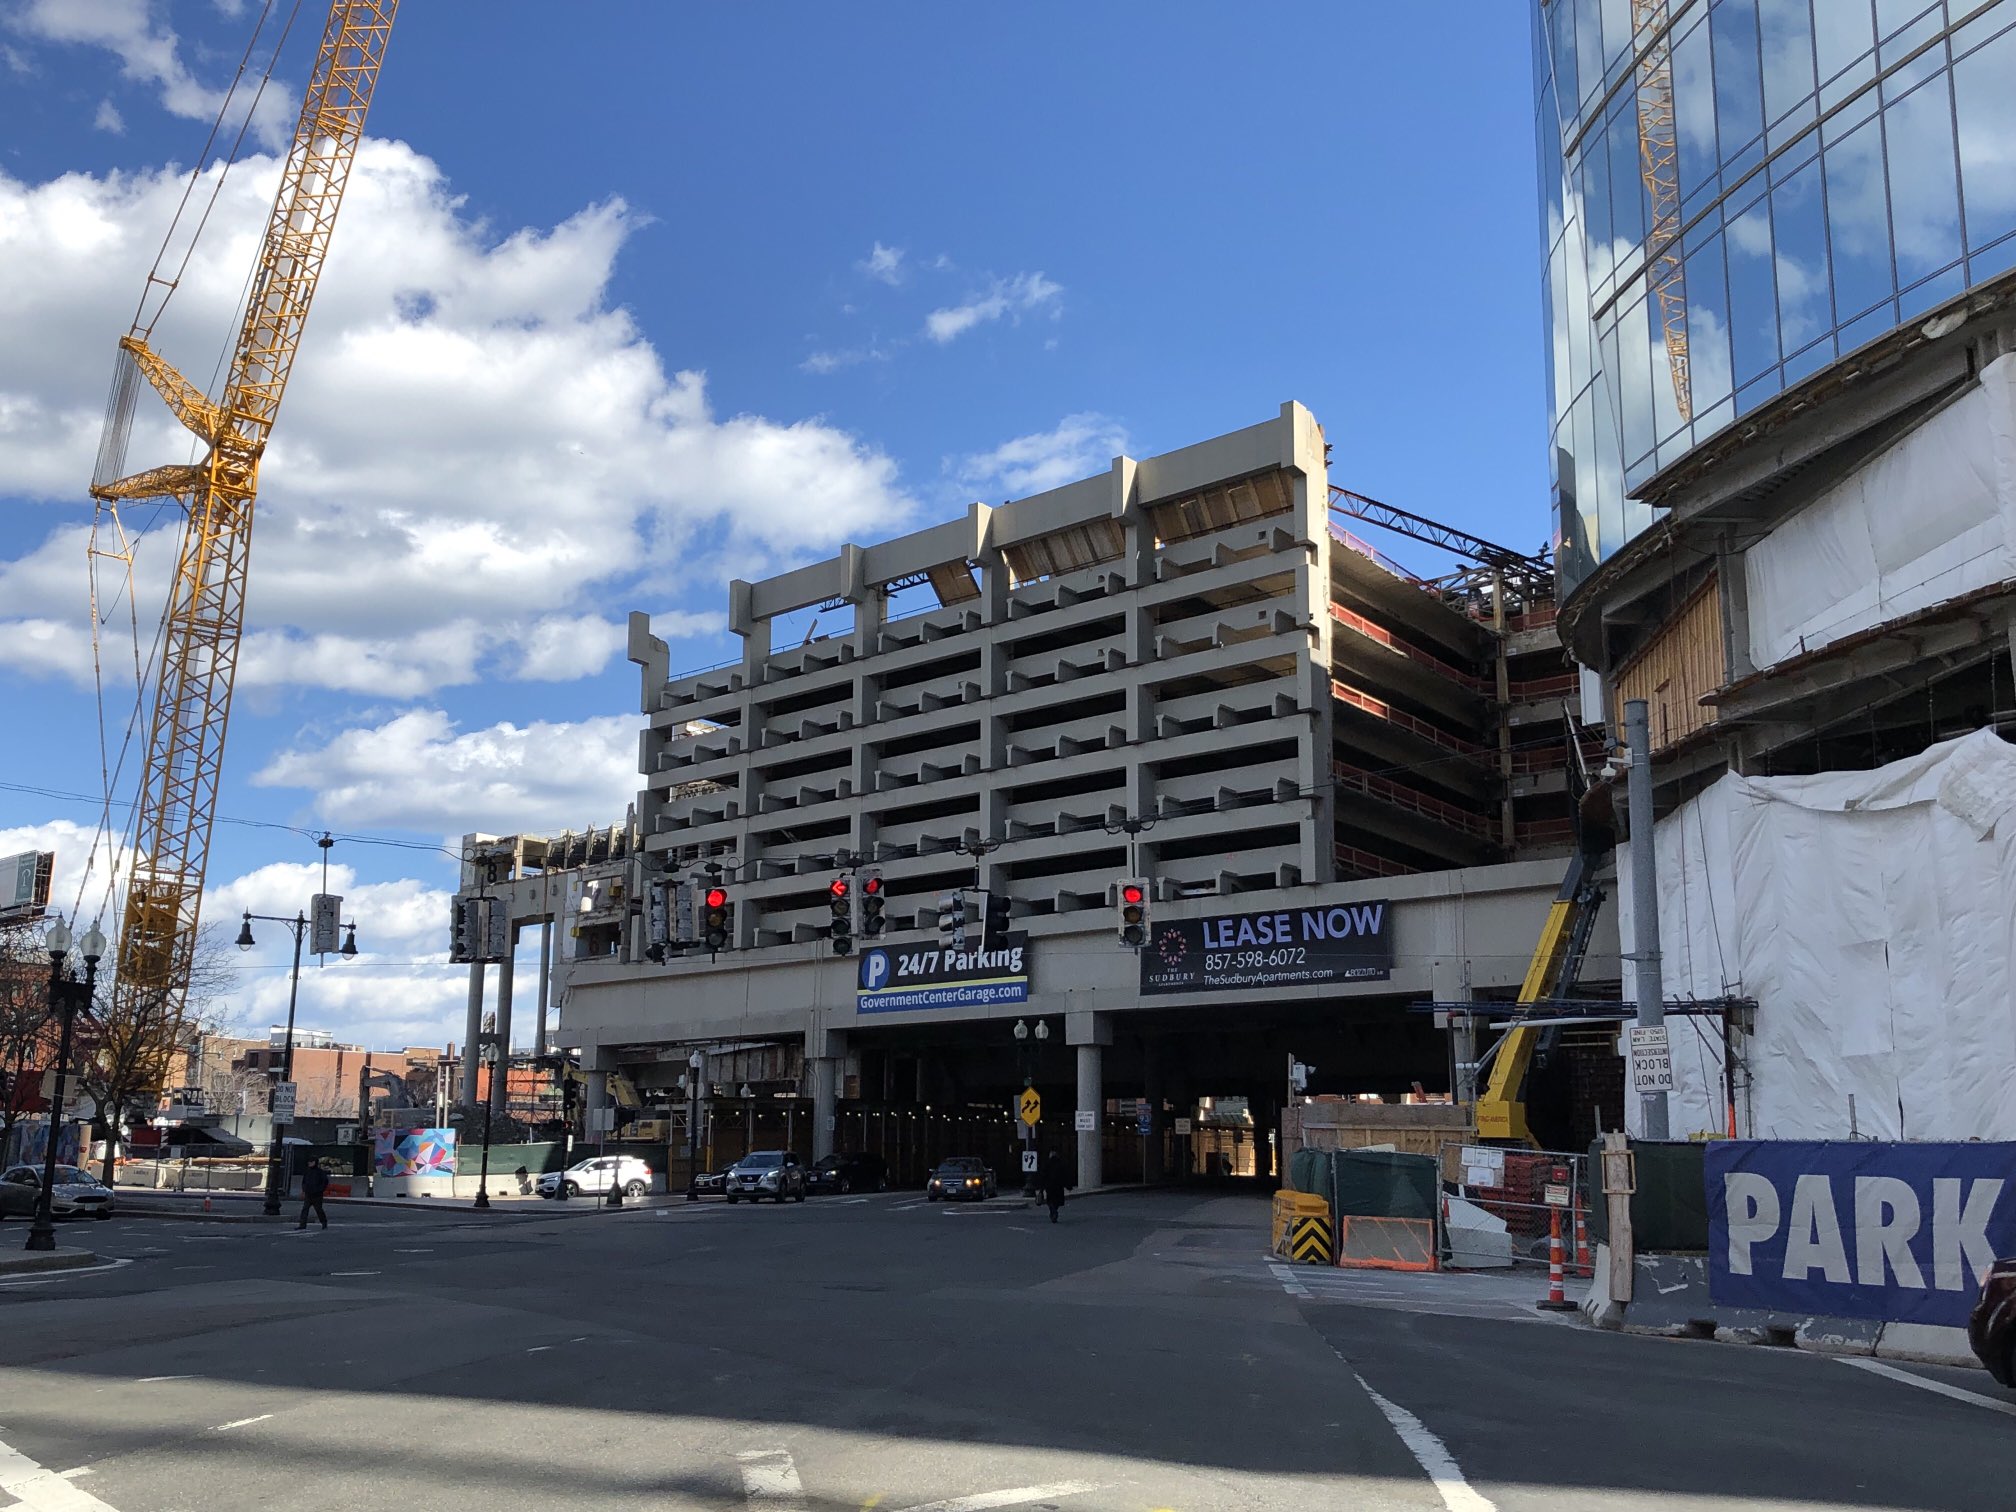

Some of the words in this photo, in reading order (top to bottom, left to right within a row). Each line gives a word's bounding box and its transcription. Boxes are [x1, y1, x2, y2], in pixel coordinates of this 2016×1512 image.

[1202, 914, 1293, 949] LEASE
[1301, 904, 1383, 941] NOW
[897, 951, 940, 976] 24/7
[944, 947, 1023, 973] Parking
[1205, 947, 1306, 971] 857-598-6072
[868, 955, 886, 988] P
[1149, 972, 1195, 983] SUDBURY
[1203, 968, 1333, 986] TheSudburyApartments.com
[860, 985, 1022, 1009] GovernmentCenterGarage.com
[1634, 1058, 1669, 1070] BLOCK
[1636, 1074, 1655, 1086] NOT
[1658, 1073, 1671, 1085] DO
[1723, 1172, 2006, 1292] PARK
